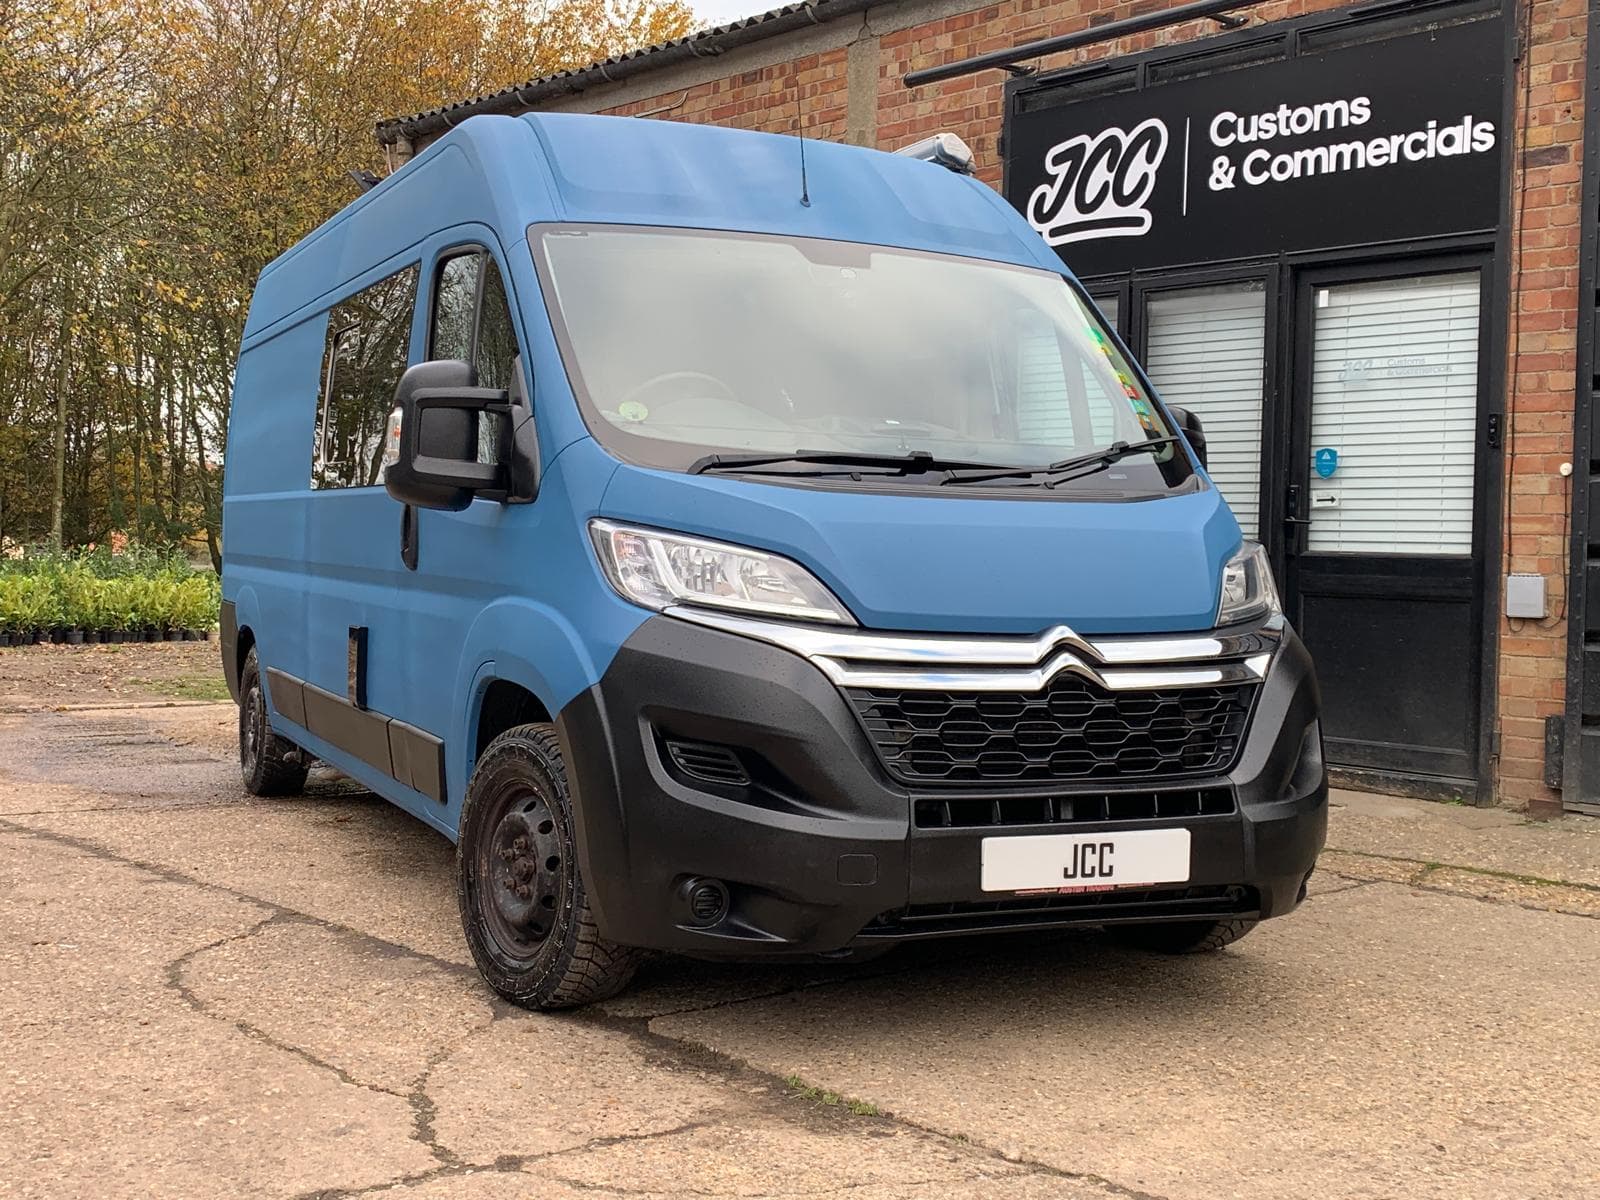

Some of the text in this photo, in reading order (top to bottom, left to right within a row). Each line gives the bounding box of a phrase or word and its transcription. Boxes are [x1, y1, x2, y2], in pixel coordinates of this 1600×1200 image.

[1209, 96, 1372, 148] Customs
[1027, 118, 1168, 228] JCC
[1208, 115, 1496, 191] & Commercials
[1387, 358, 1426, 368] Customs
[1063, 842, 1114, 879] JCC
